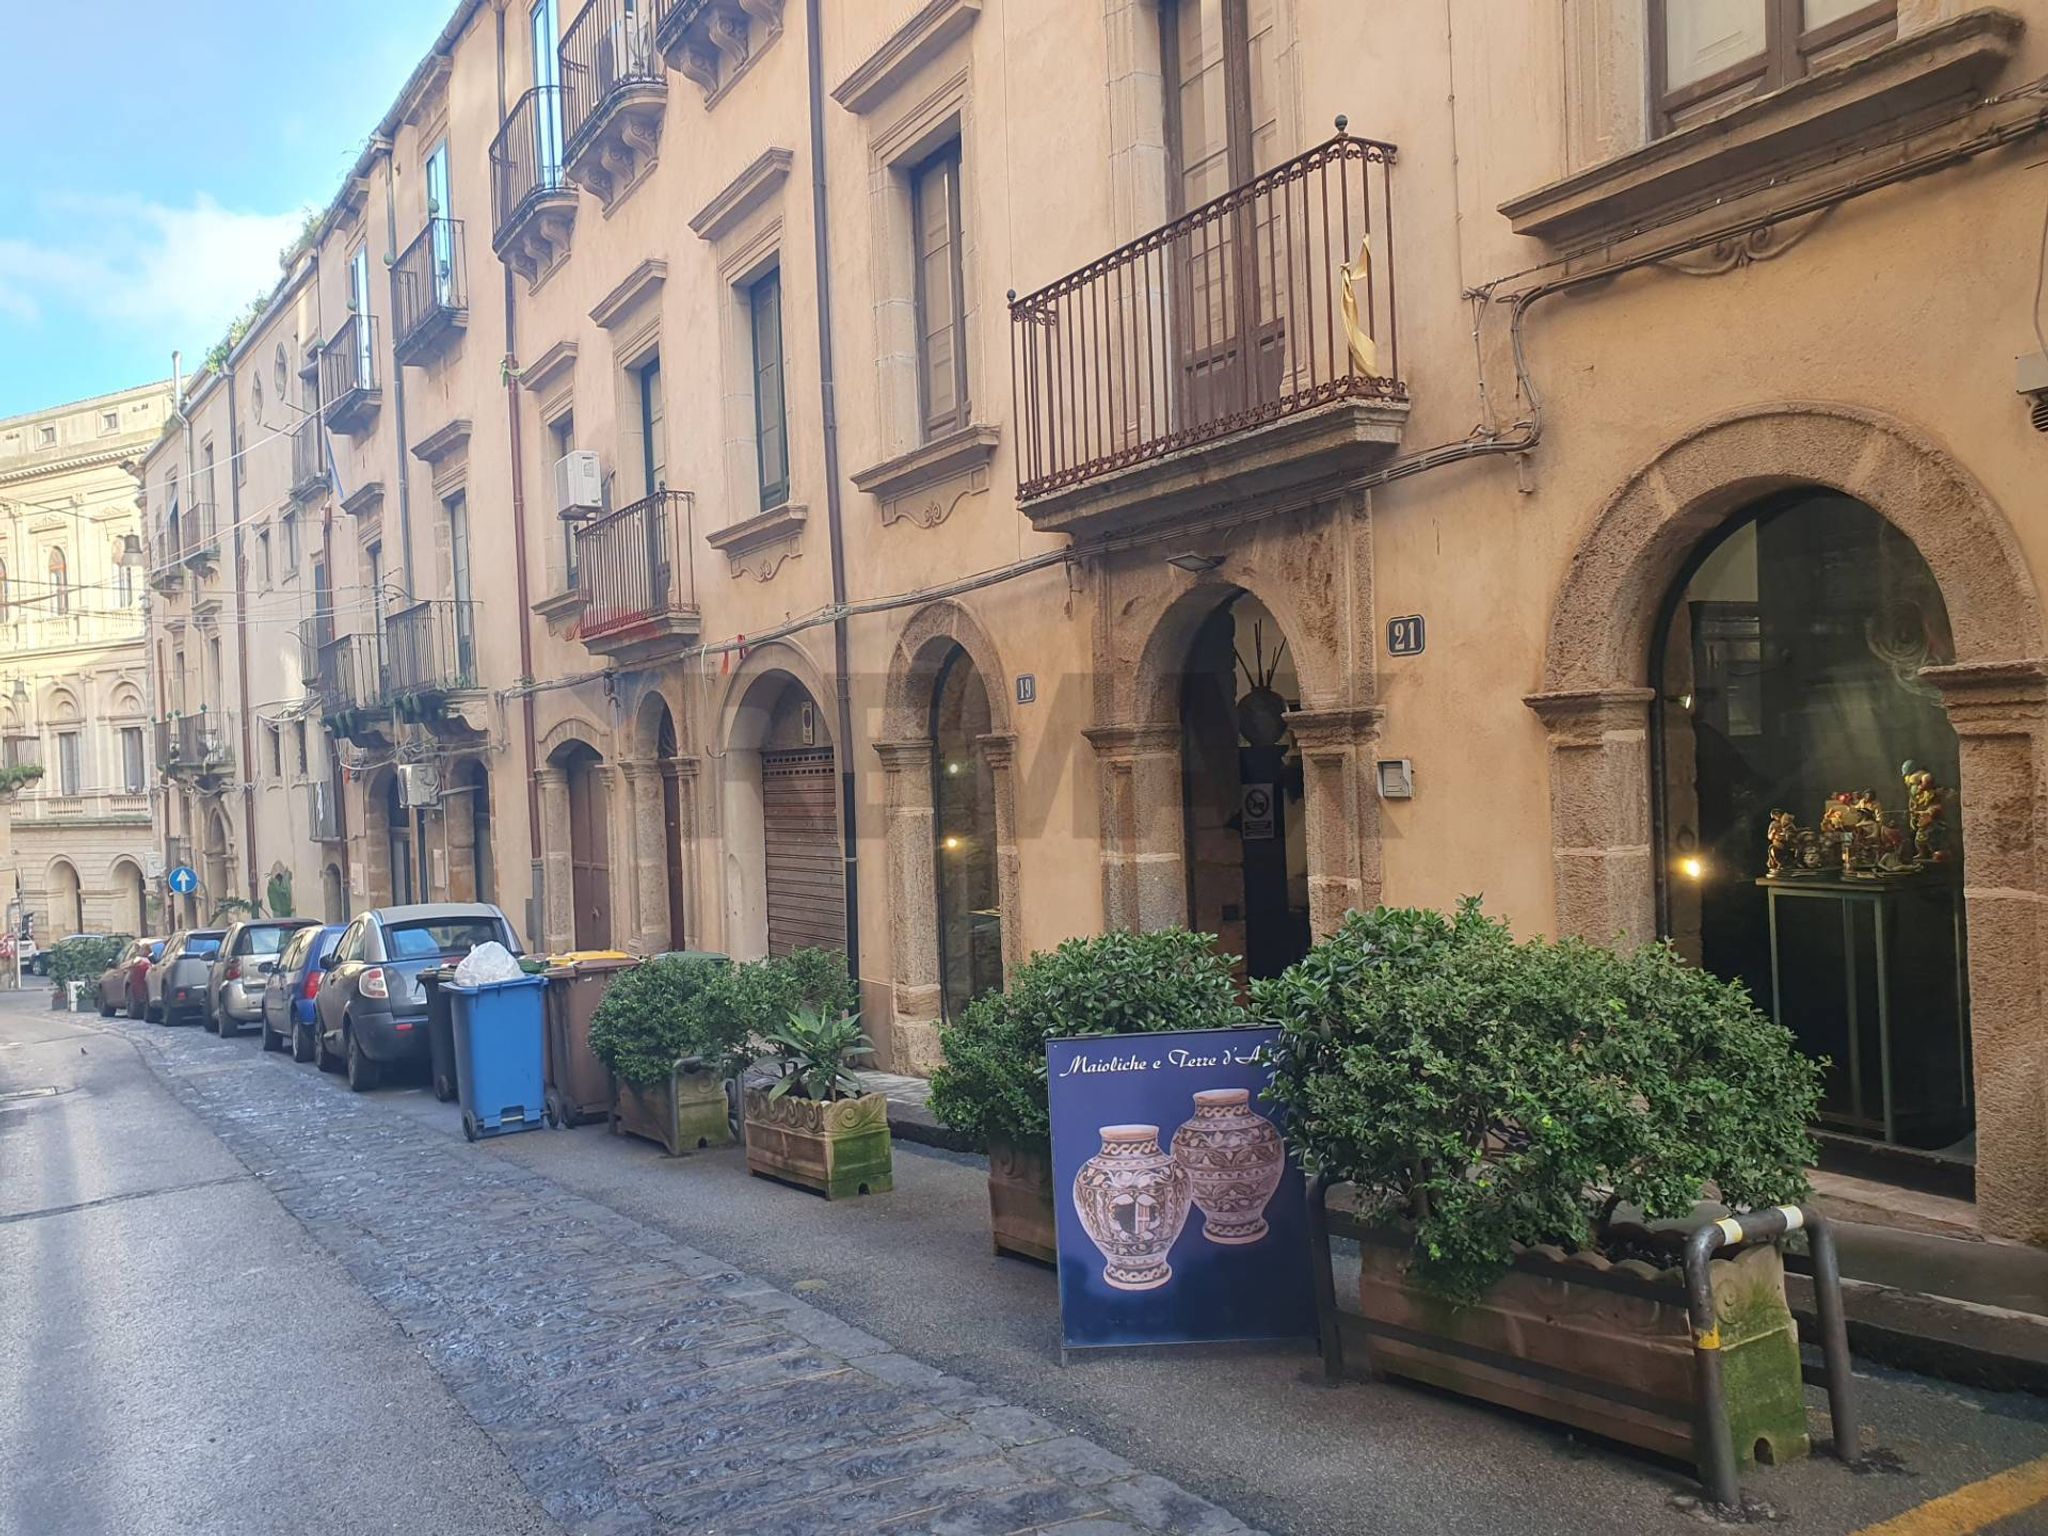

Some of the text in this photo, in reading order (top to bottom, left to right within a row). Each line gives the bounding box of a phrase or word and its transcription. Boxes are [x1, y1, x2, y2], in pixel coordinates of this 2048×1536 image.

[1394, 621, 1416, 650] 21
[1020, 678, 1031, 699] 19
[1059, 1054, 1147, 1077] Maioliche
[1152, 1060, 1161, 1069] e
[1168, 1049, 1217, 1068] Terre
